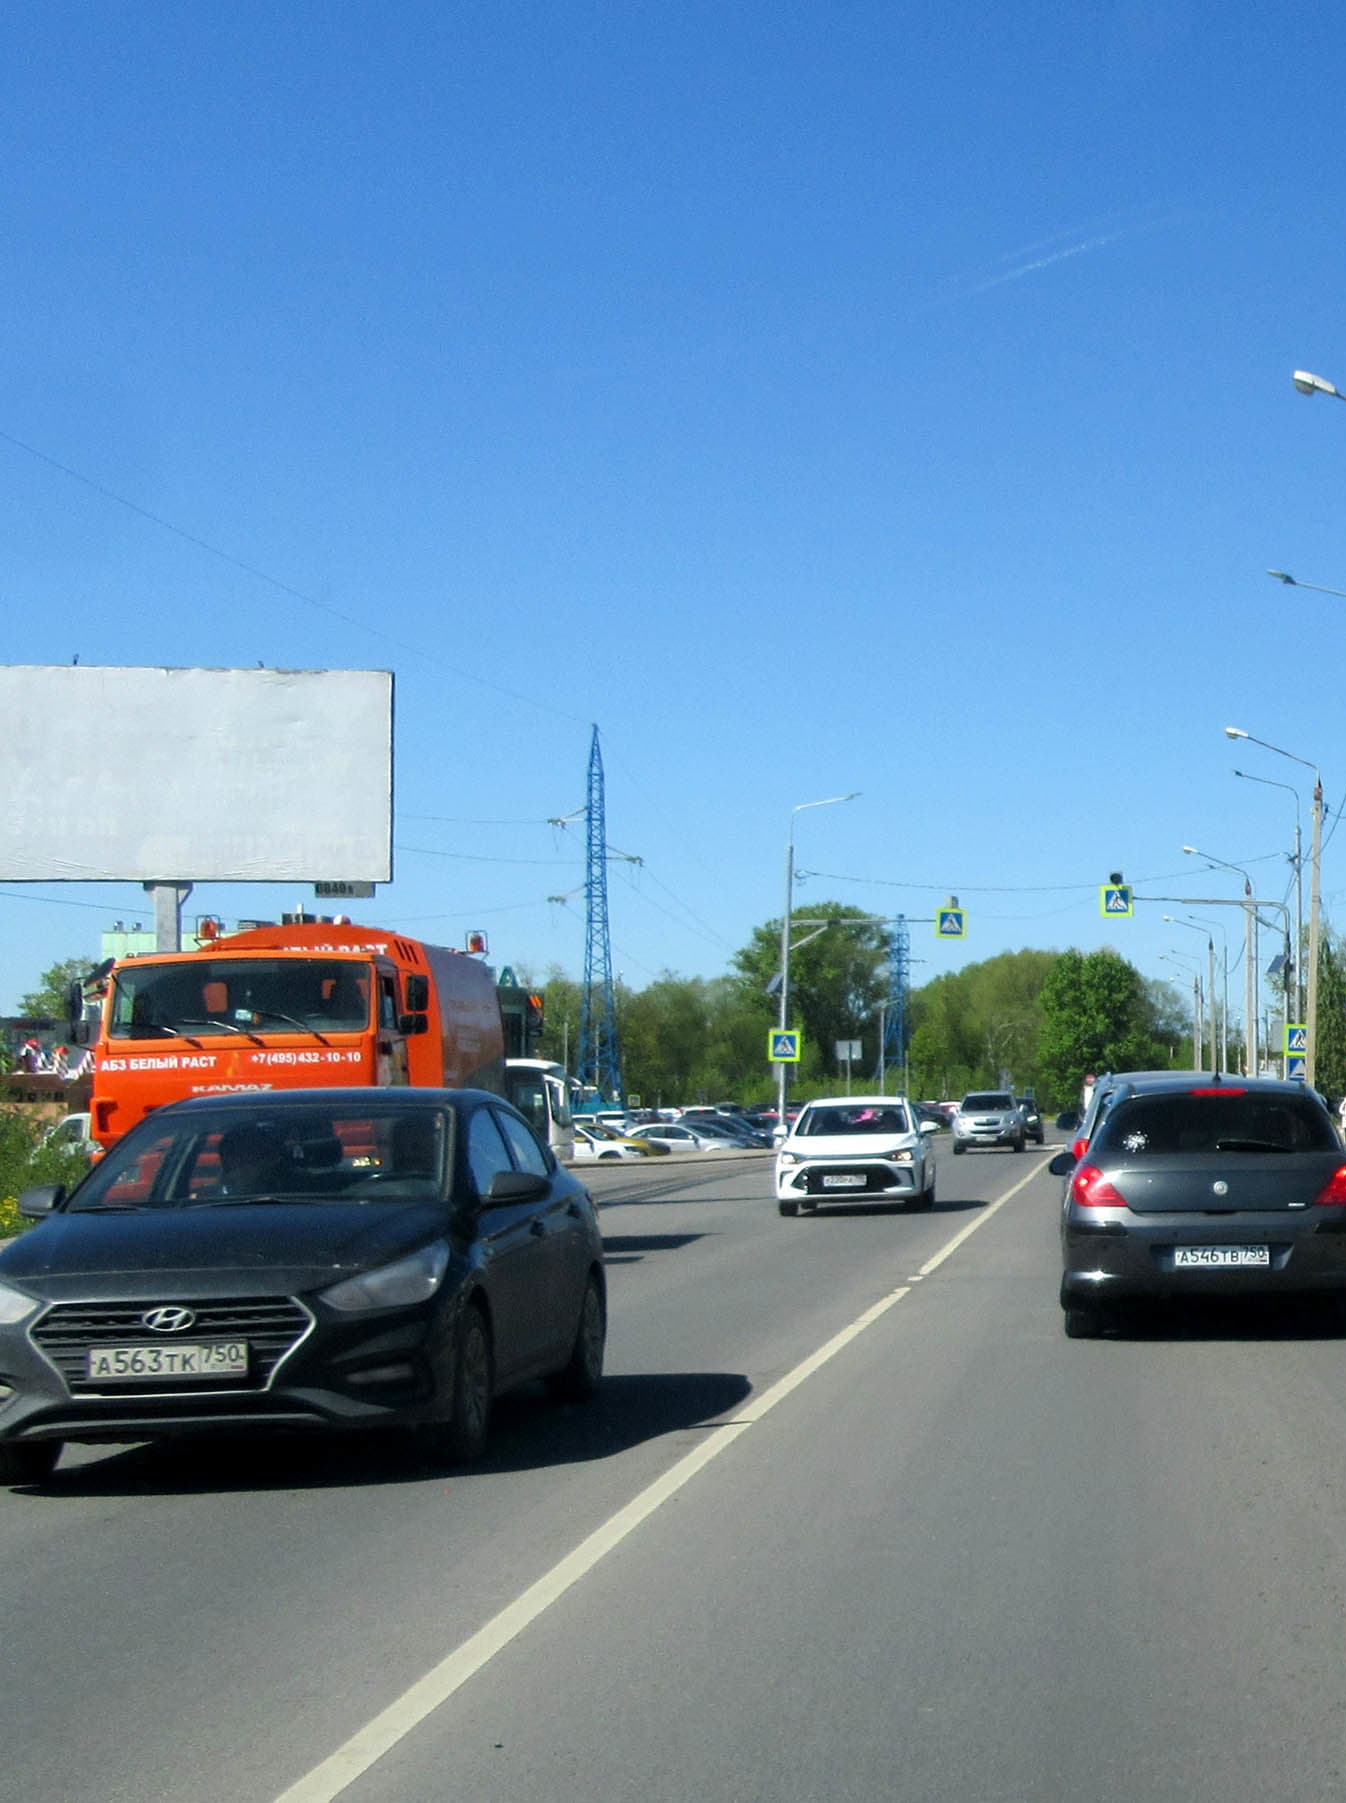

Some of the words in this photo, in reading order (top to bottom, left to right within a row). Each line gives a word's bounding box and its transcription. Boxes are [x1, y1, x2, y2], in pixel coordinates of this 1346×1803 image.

[101, 1059, 127, 1072] АБЗ
[130, 1057, 178, 1070] БЕЛЫЙ
[182, 1056, 216, 1068] РАСТ
[96, 1350, 196, 1375] А563ТК
[201, 1345, 240, 1363] 750
